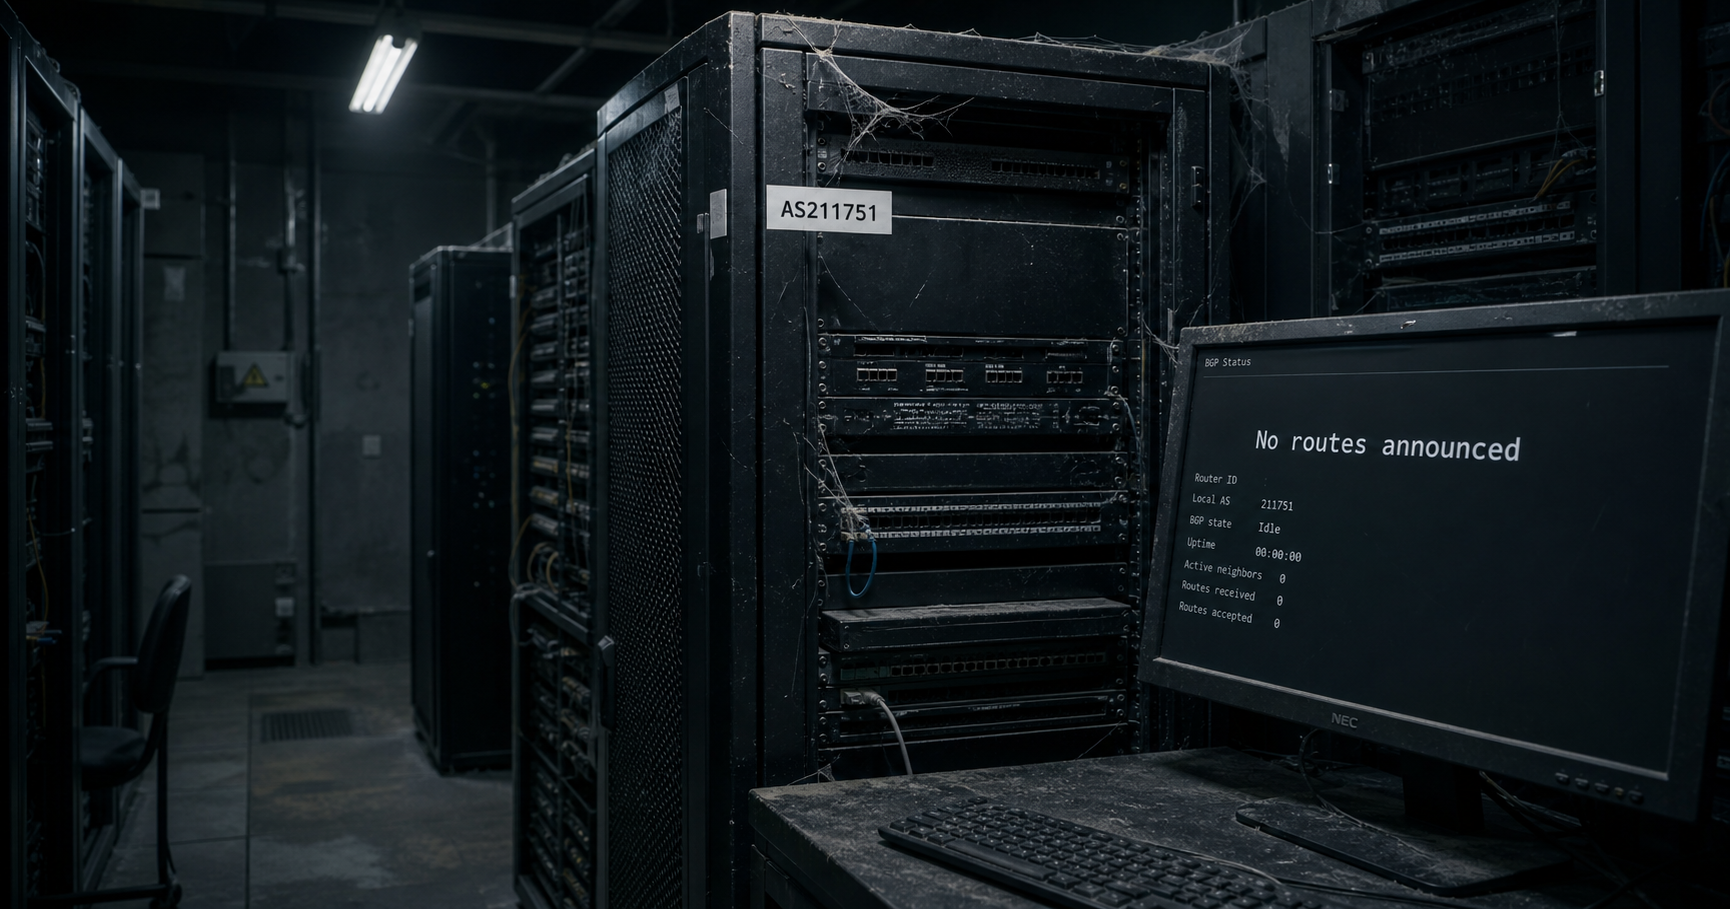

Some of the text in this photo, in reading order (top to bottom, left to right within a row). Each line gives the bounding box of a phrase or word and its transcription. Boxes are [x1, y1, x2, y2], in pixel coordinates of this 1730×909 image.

[780, 200, 876, 222] AS211751
[1204, 357, 1252, 368] BGP Status
[1255, 429, 1521, 462] No routes announced
[1194, 472, 1238, 485] Router ID
[1192, 493, 1293, 512] Local AS 211751
[1189, 514, 1281, 535] BGP state Idle
[1187, 536, 1302, 563] Uptime 00:00:00
[1183, 559, 1286, 585] Active neighbors 0
[1181, 579, 1284, 607] Routes received 0
[1178, 600, 1281, 629] Routes accepted 0
[1331, 711, 1359, 729] NEC
